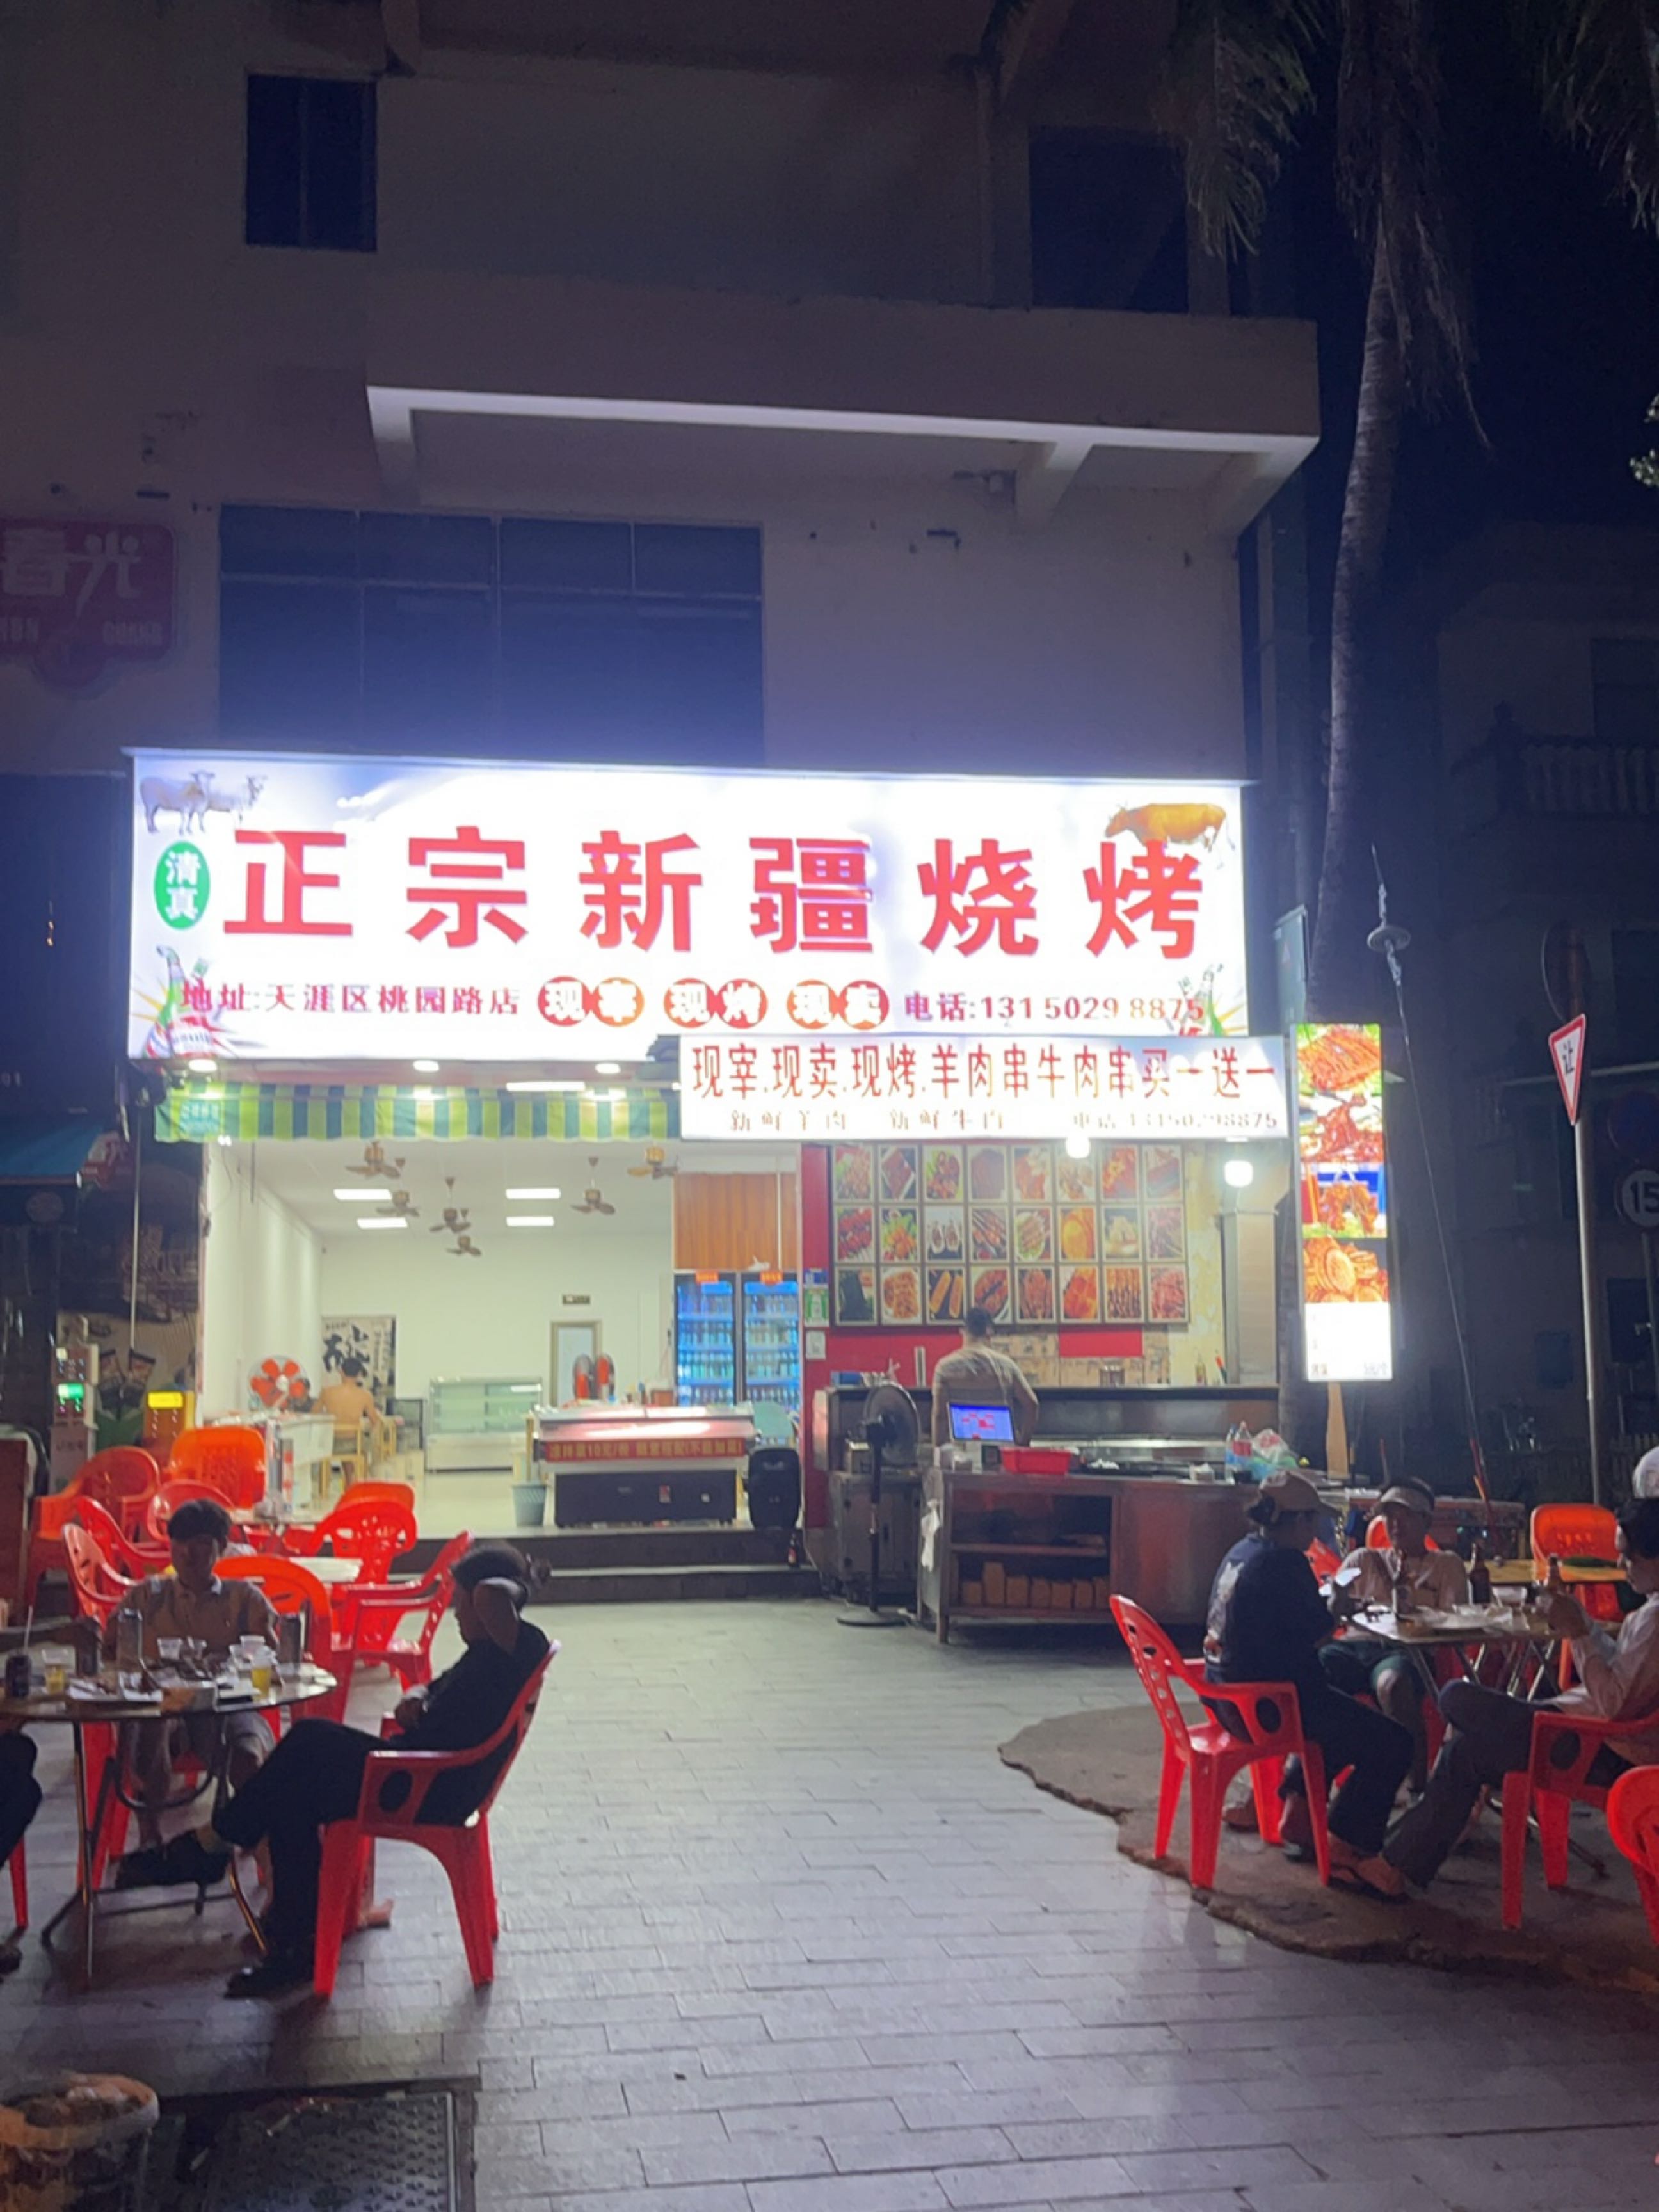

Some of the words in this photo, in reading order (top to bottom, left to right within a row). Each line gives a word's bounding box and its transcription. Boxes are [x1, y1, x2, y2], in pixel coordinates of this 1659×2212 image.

[164, 850, 201, 920] 清真
[223, 825, 1203, 959] 正宗新疆烧烤
[1044, 997, 1120, 1020] 5029
[1129, 997, 1205, 1021] 8875
